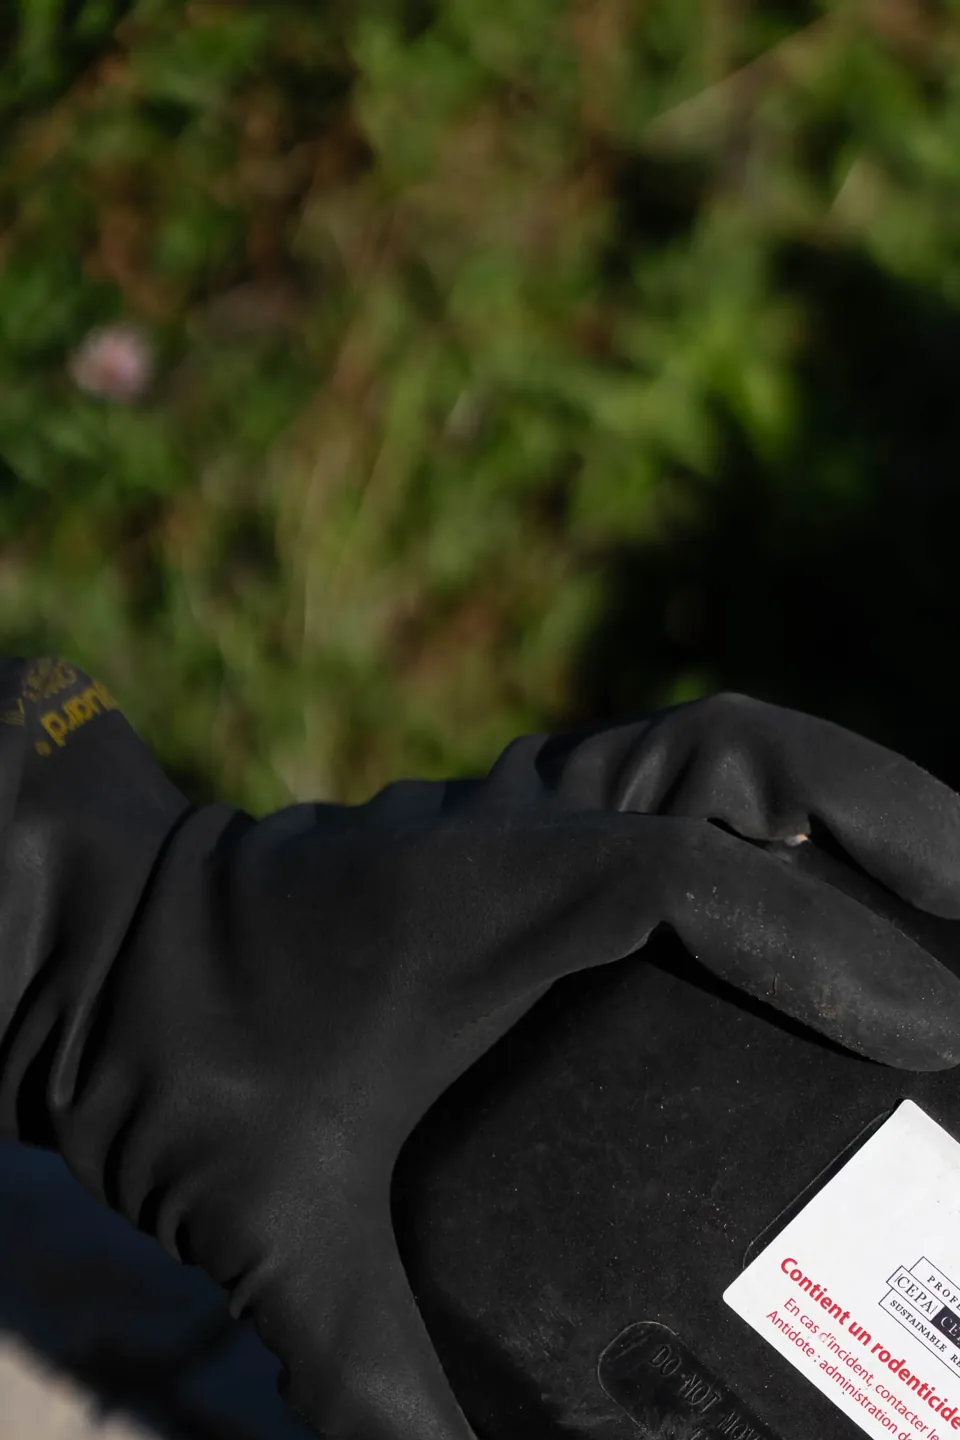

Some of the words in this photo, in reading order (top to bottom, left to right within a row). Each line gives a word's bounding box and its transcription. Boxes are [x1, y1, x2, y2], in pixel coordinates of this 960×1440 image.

[780, 1257, 850, 1325] Contient
[848, 1321, 871, 1346] un
[889, 1299, 946, 1352] SUSTAINABLE
[897, 1276, 932, 1312] CEPA
[766, 1310, 814, 1356] Antidote
[818, 1359, 897, 1433] administration
[783, 1297, 799, 1316] En
[799, 1315, 819, 1333] cas
[875, 1384, 928, 1432] contacter
